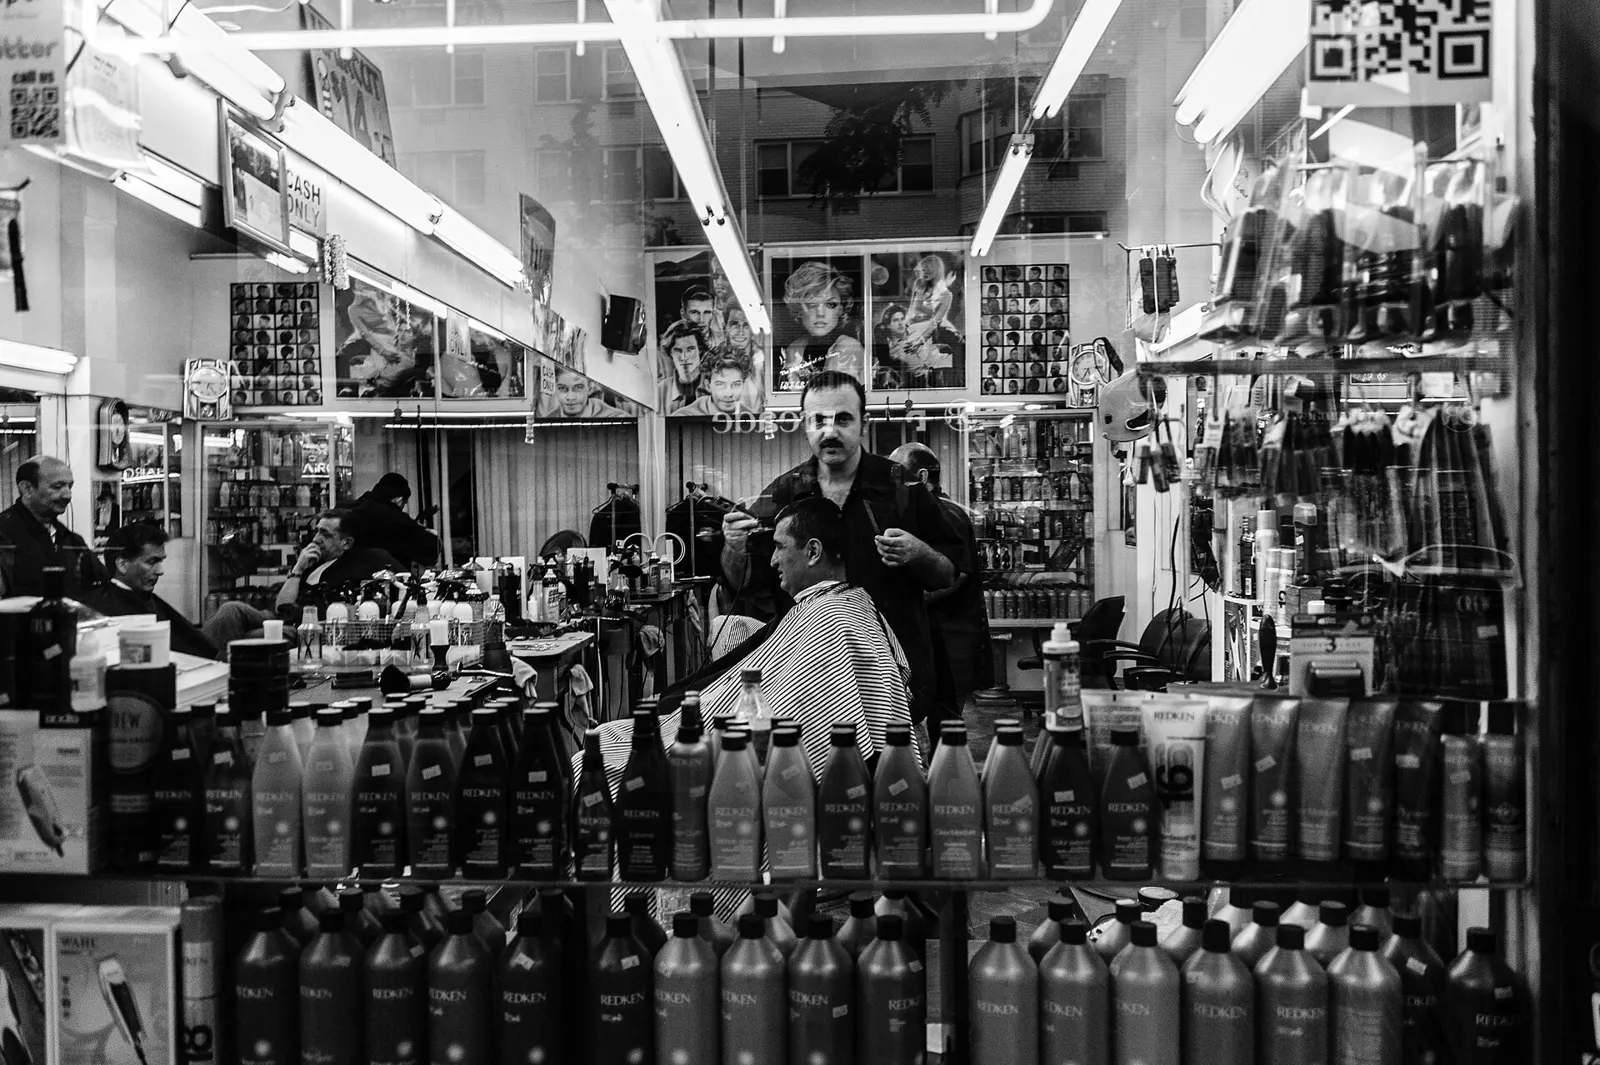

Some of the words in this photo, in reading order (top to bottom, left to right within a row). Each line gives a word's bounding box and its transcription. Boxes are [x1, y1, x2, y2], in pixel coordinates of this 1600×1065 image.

[286, 169, 321, 206] CASH
[287, 193, 321, 228] ONLY
[1154, 712, 1195, 721] REDKEN
[411, 792, 450, 801] REDKEN
[463, 789, 500, 798] REDKEN
[1050, 806, 1091, 815] REDKEN
[1108, 803, 1149, 812] REDKEN
[503, 991, 547, 1004] REDKEN
[600, 992, 645, 1006] REDKEN
